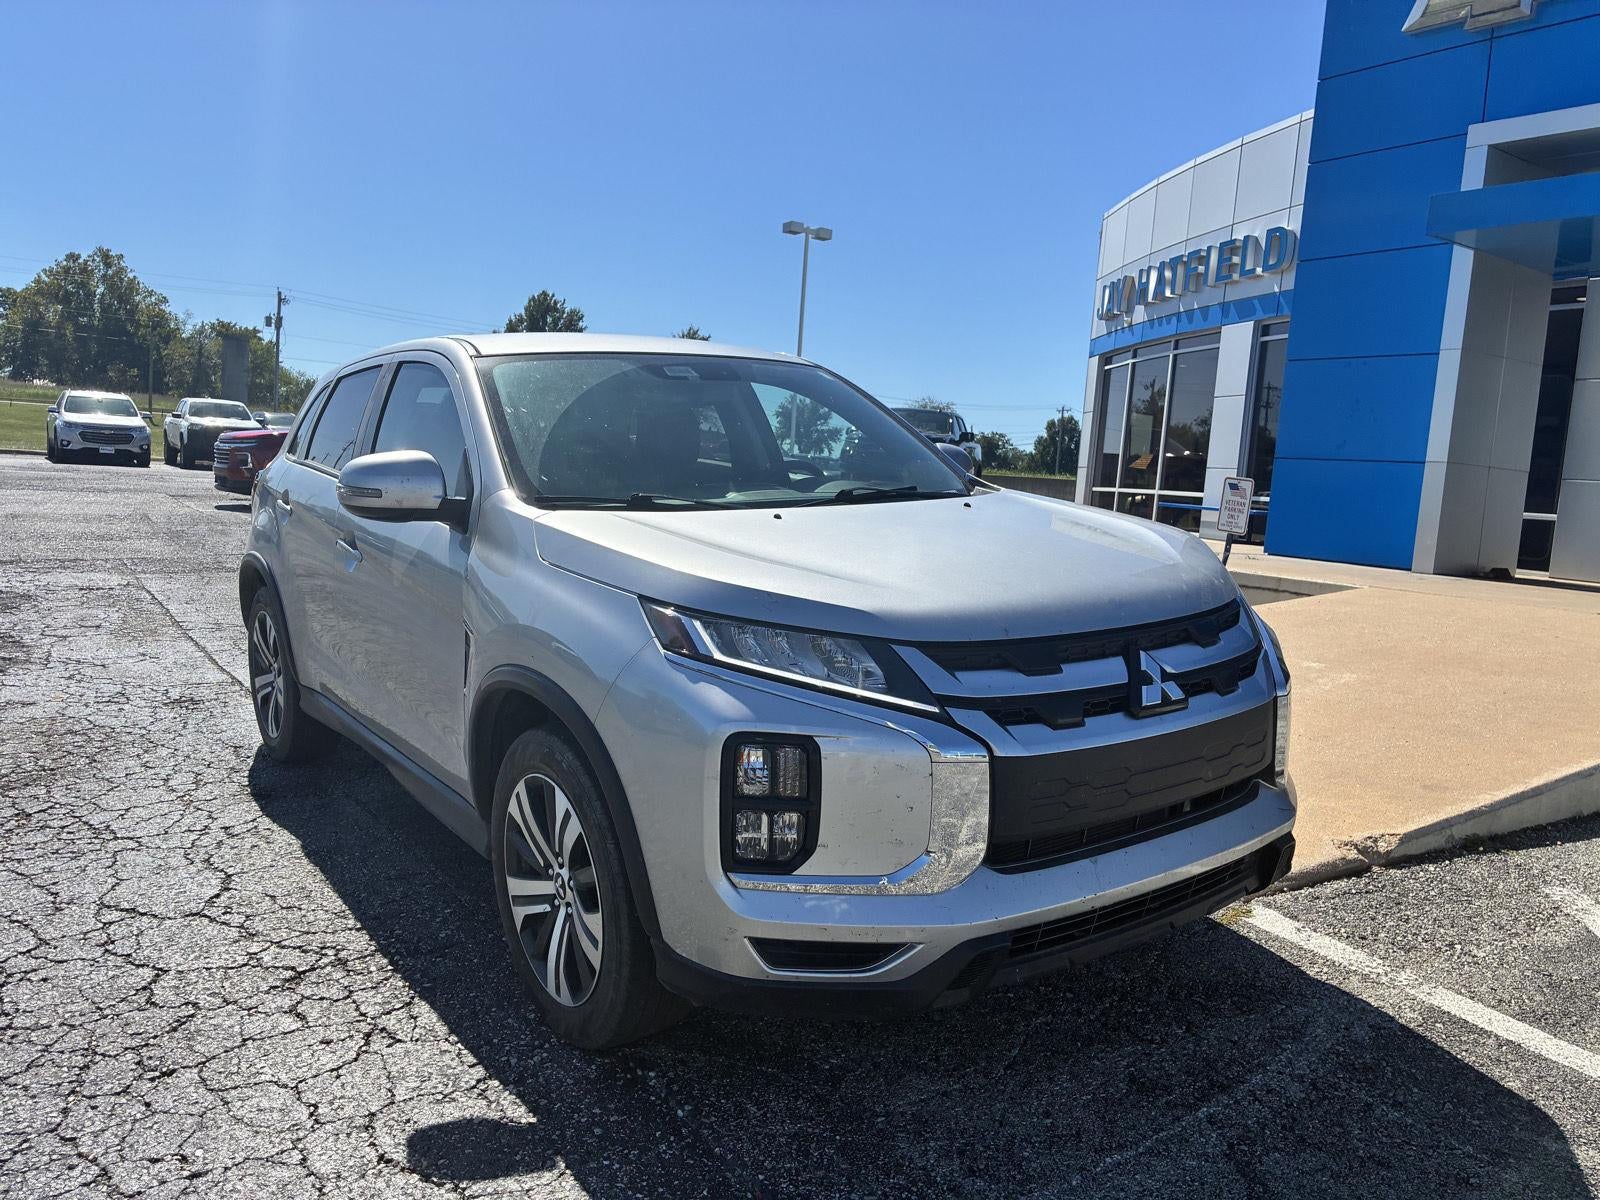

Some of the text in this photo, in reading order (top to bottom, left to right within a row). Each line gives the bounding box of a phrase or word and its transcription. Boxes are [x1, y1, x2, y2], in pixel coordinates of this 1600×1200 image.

[1097, 226, 1297, 320] JAY HATFIELD
[1225, 499, 1246, 507] VETERAN
[1224, 506, 1245, 514] PARKING
[1227, 513, 1240, 521] ONLY
